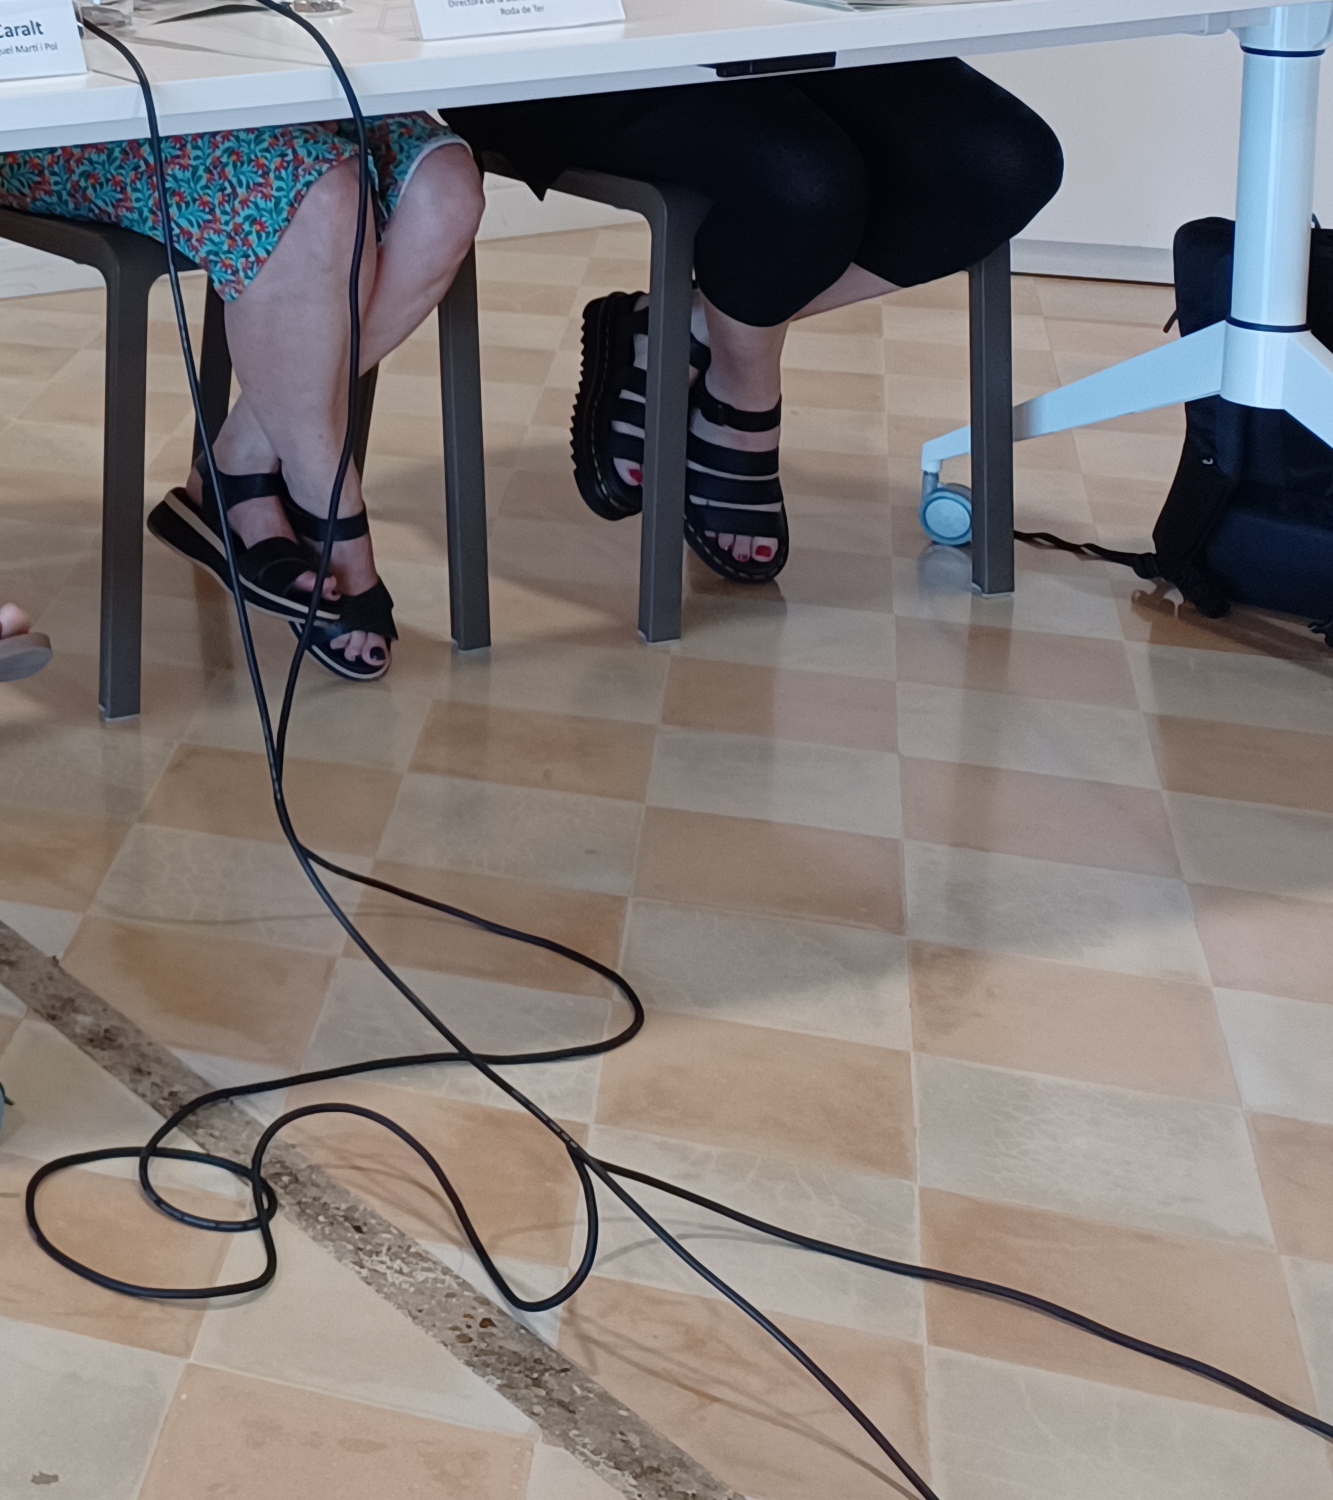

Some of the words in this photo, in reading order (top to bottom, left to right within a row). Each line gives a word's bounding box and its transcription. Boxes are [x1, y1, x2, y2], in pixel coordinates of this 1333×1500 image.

[15, 44, 39, 54] Martí
[40, 43, 44, 52] i
[44, 42, 58, 51] Pol
